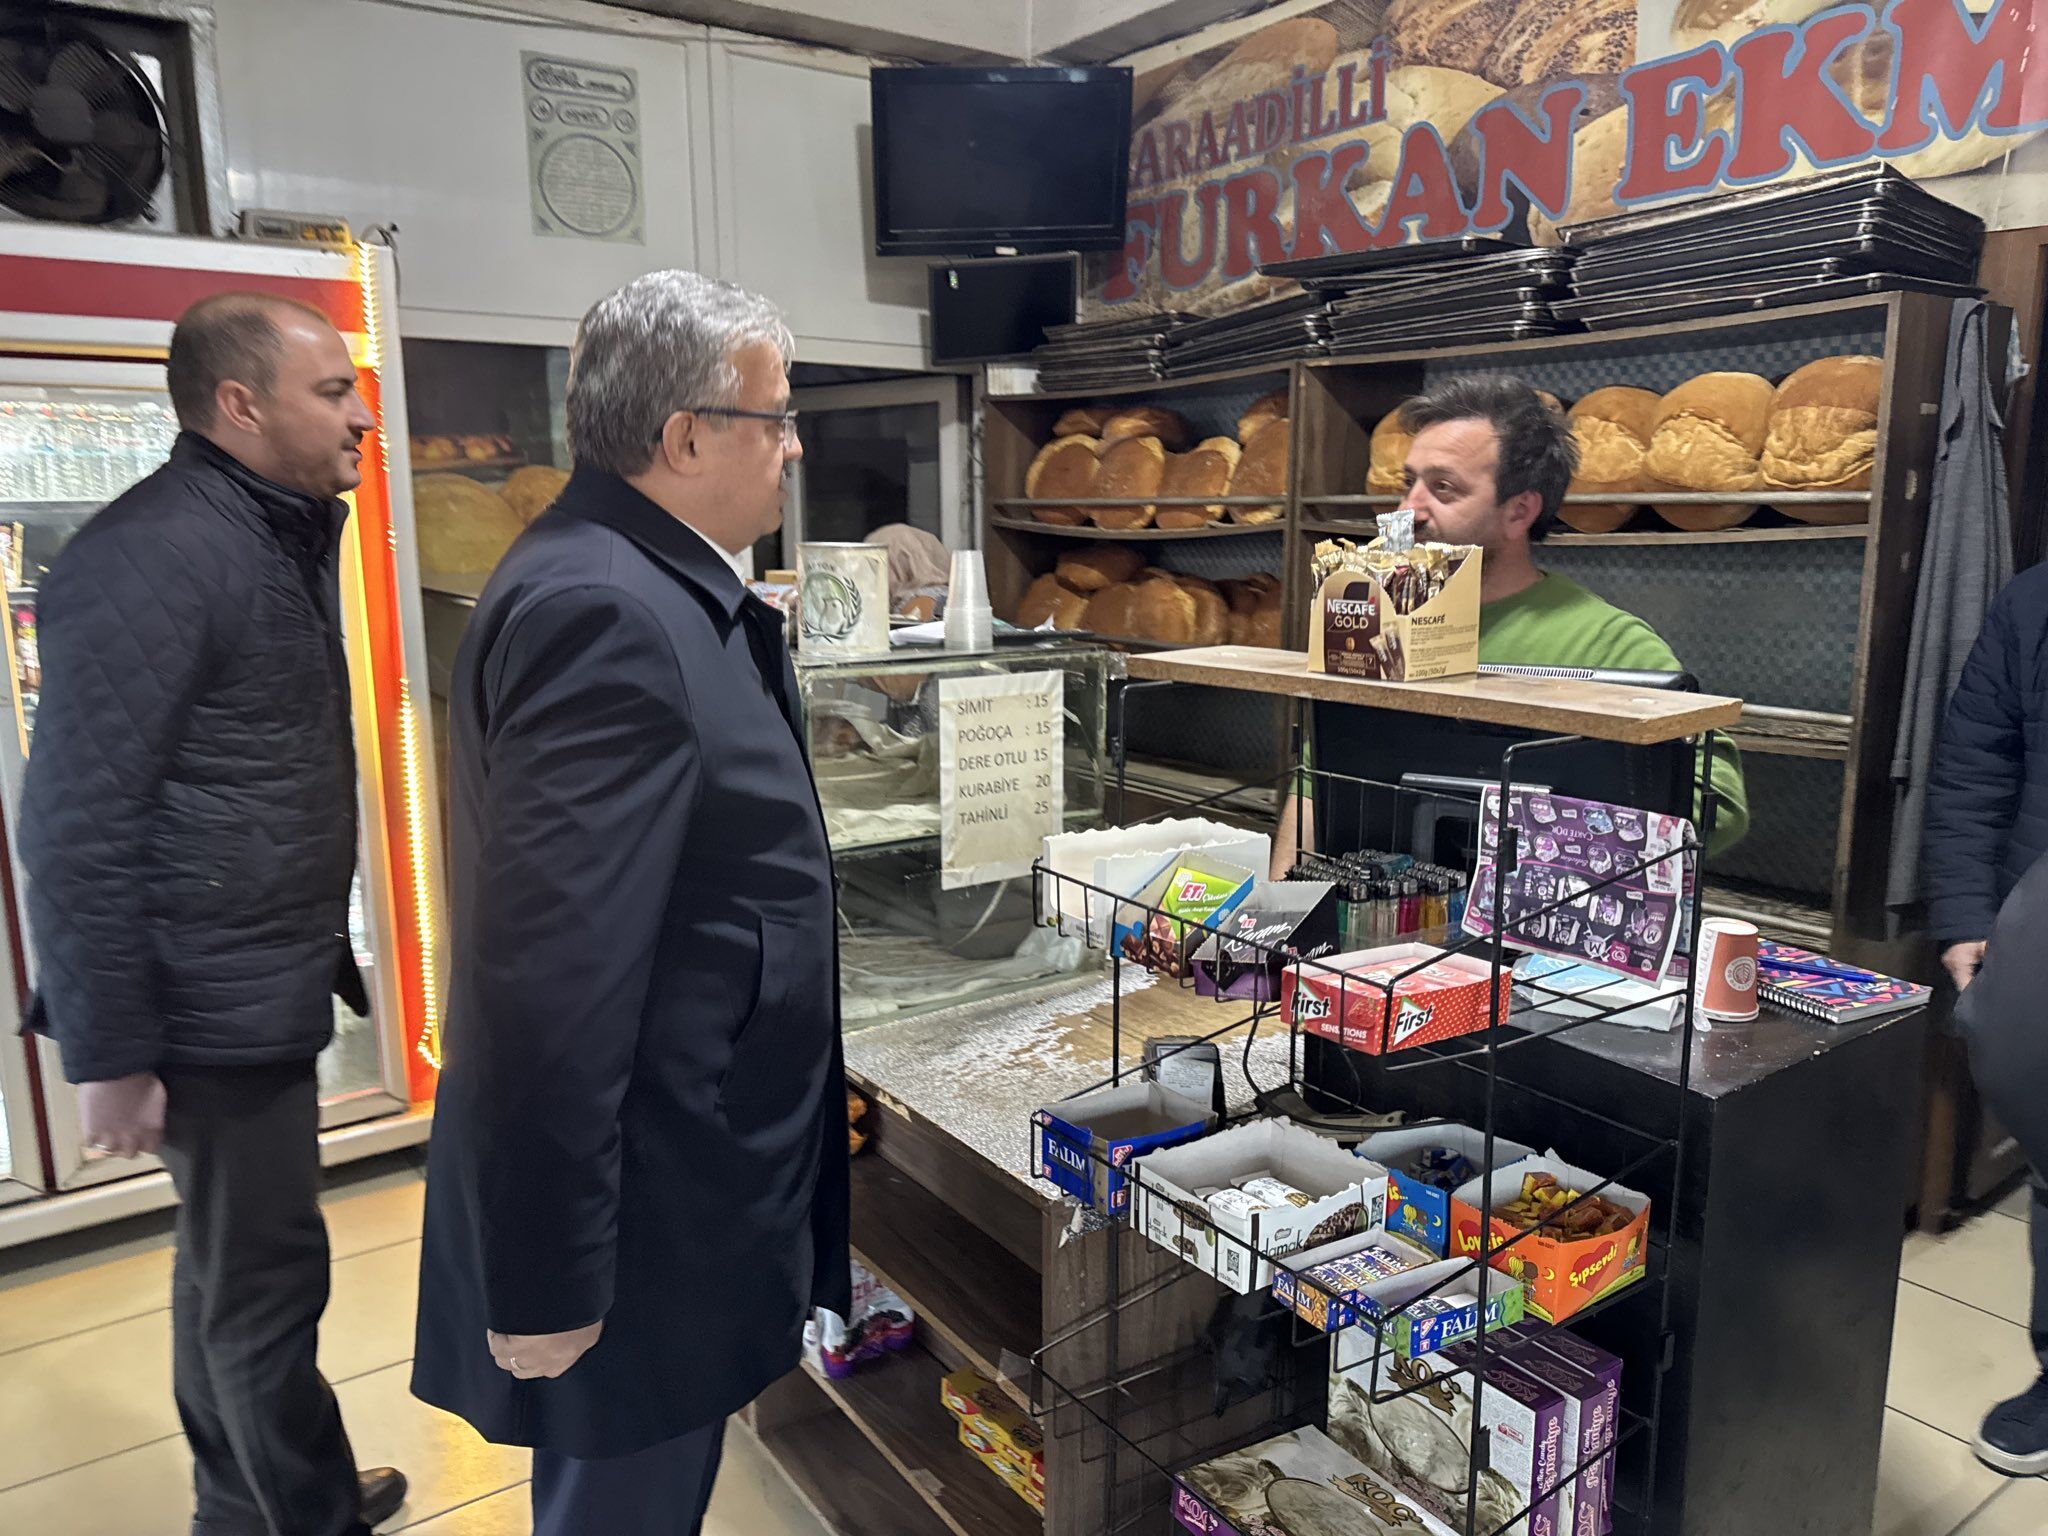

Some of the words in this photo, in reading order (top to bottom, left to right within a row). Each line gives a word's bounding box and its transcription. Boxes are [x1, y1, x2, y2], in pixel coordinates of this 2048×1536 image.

[1130, 35, 1393, 192] ARAADİLLİ
[1102, 80, 1587, 304] FURKAN
[1334, 615, 1369, 630] GOLD
[957, 697, 994, 716] SİMİT
[958, 724, 1013, 744] POĞOÇA
[1036, 721, 1050, 736] 15
[958, 754, 991, 772] DERE
[994, 750, 1028, 767] OTLU
[1034, 748, 1049, 762] 15
[958, 777, 1020, 799] KURABİYE
[1036, 774, 1050, 788] 20
[959, 804, 1009, 825] TAHİNLİ
[1034, 801, 1049, 815] 25
[1291, 991, 1331, 1018] First
[1321, 1023, 1367, 1039] SENSTIONS
[1393, 1002, 1434, 1037] First
[1047, 1137, 1087, 1172] FALIM
[1261, 1229, 1304, 1261] damak
[1457, 1228, 1491, 1252] Lov
[1360, 1302, 1394, 1335] FALM
[1441, 1302, 1498, 1339] FALM
